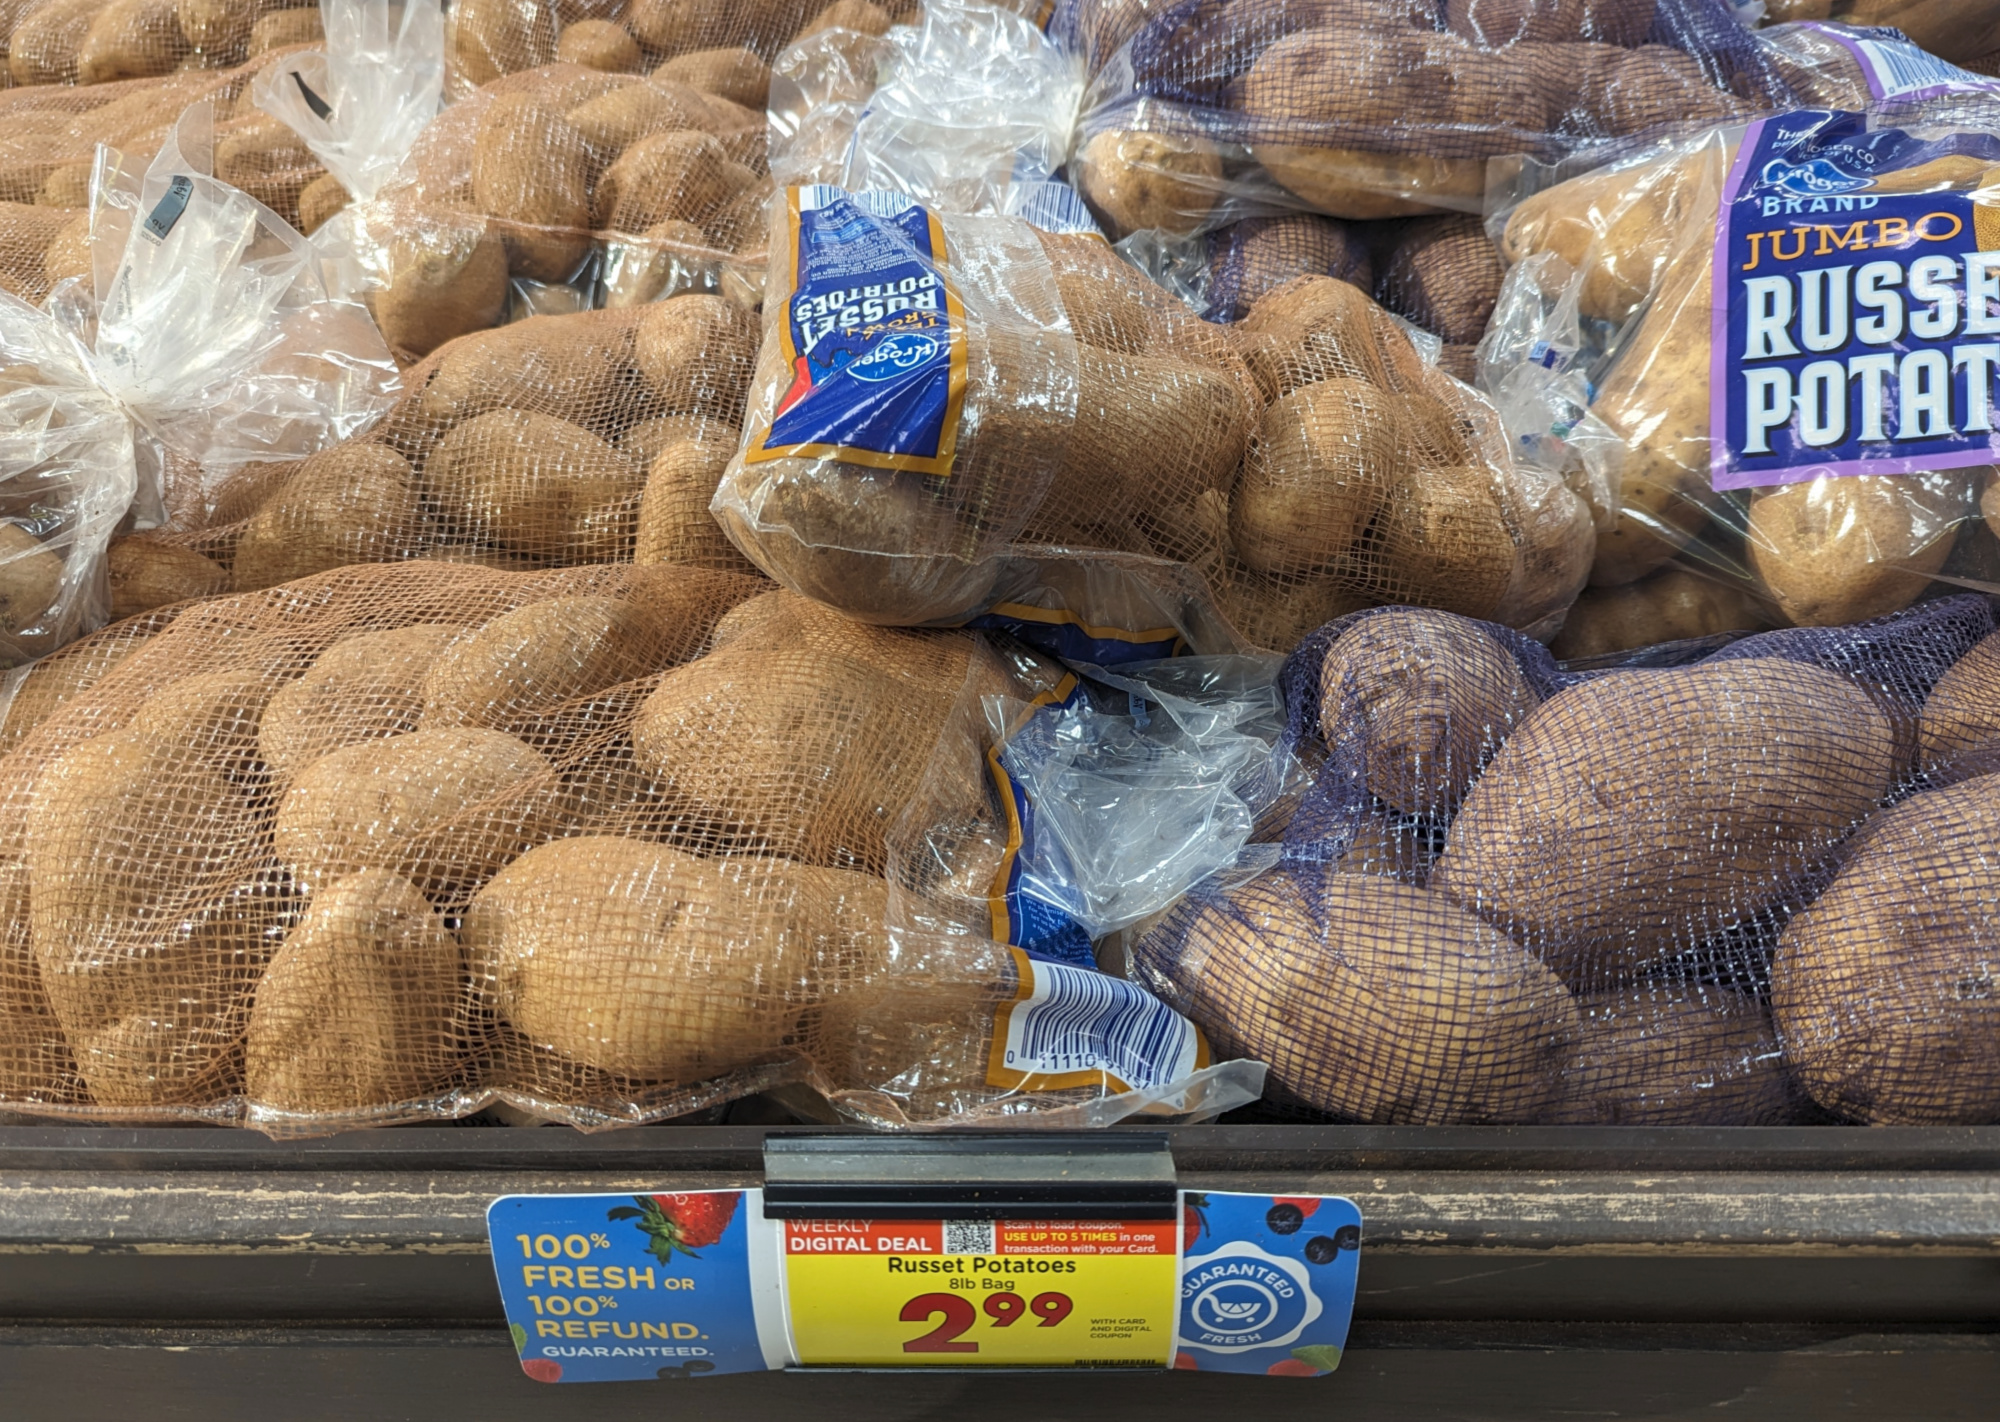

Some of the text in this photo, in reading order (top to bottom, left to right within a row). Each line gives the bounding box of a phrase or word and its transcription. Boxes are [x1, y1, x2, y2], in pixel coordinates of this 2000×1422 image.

[1762, 196, 1879, 217] BRAND
[1742, 211, 1963, 270] JUMBO
[796, 272, 936, 322] POTATOES
[1741, 250, 2000, 359] RUSSE
[802, 290, 937, 356] RUSSET
[1741, 343, 2000, 454] POTAT
[1007, 1051, 1015, 1063] 0
[789, 1219, 873, 1233] WEEKLY
[1004, 1220, 1125, 1231] Scan to load coupon.
[516, 1233, 610, 1259] 100%
[791, 1237, 932, 1251] DIGITAL DEAL
[1004, 1232, 1028, 1241] USE
[1031, 1232, 1048, 1241] UP
[1051, 1232, 1068, 1241] TO
[1071, 1232, 1078, 1241] 5
[1080, 1232, 1117, 1241] TIMES
[1119, 1232, 1131, 1241] in
[1004, 1244, 1159, 1255] transaction with your Card.
[889, 1257, 1076, 1273] Russet Potatoes
[522, 1265, 695, 1290] FRESH OR
[949, 1278, 1015, 1291] 8lb Bag
[1181, 1263, 1295, 1299] GUARANTEED
[527, 1295, 618, 1316] 100%
[535, 1320, 709, 1339] REFUND.
[1200, 1333, 1262, 1344] FRESH
[542, 1346, 715, 1357] GUARANTEED.
